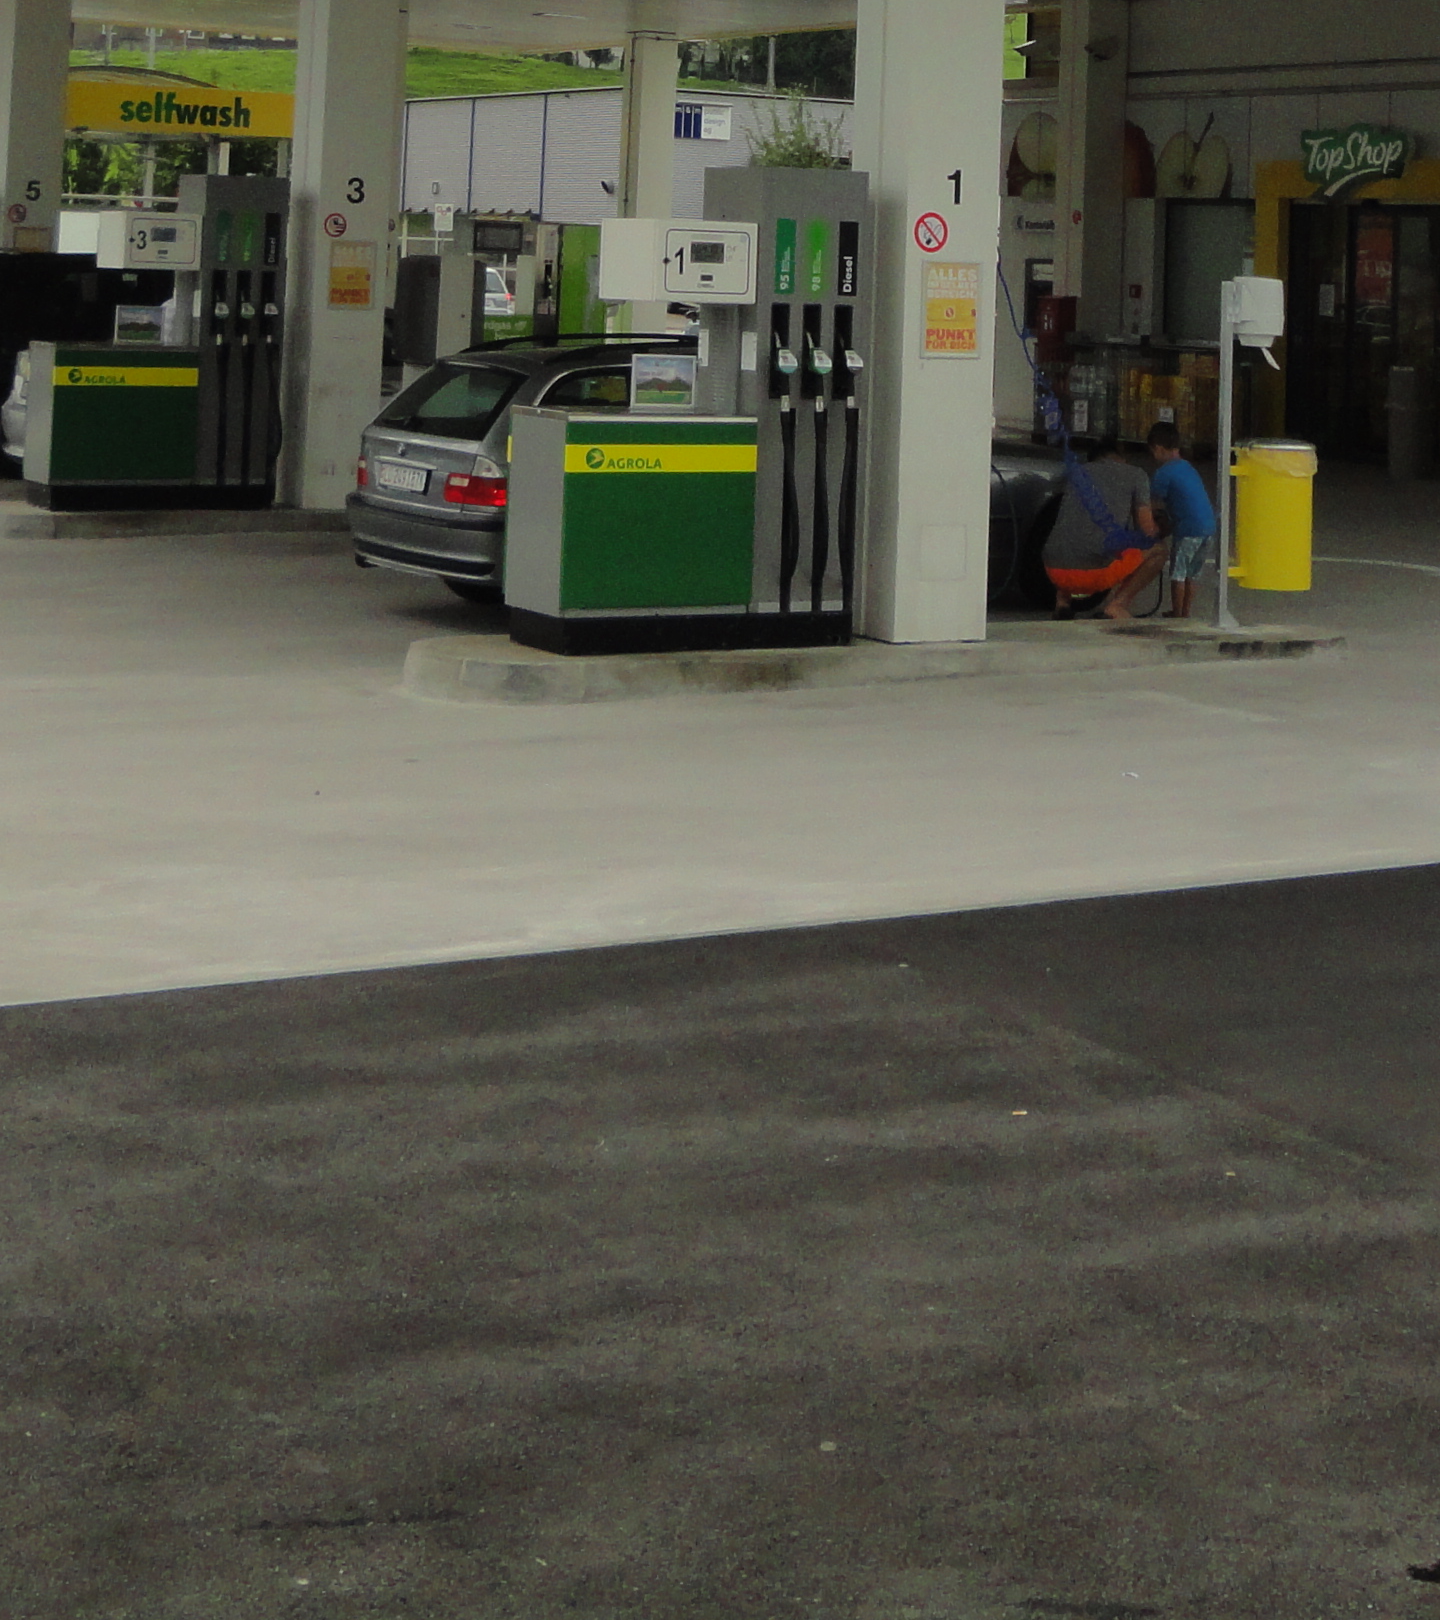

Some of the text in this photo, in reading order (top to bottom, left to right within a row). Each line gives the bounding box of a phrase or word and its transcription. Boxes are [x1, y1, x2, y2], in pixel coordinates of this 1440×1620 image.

[120, 92, 251, 129] selfwash
[25, 181, 41, 201] 5
[346, 177, 365, 204] 3
[947, 169, 962, 205] 1
[136, 230, 148, 250] 3
[674, 247, 684, 275] 1
[779, 274, 790, 290] 95
[811, 276, 822, 292] 98
[842, 256, 854, 293] Diesel
[928, 268, 978, 281] ALLES
[925, 329, 977, 340] PUNKT
[84, 375, 127, 384] AGROLA
[607, 457, 663, 470] AGROLA
